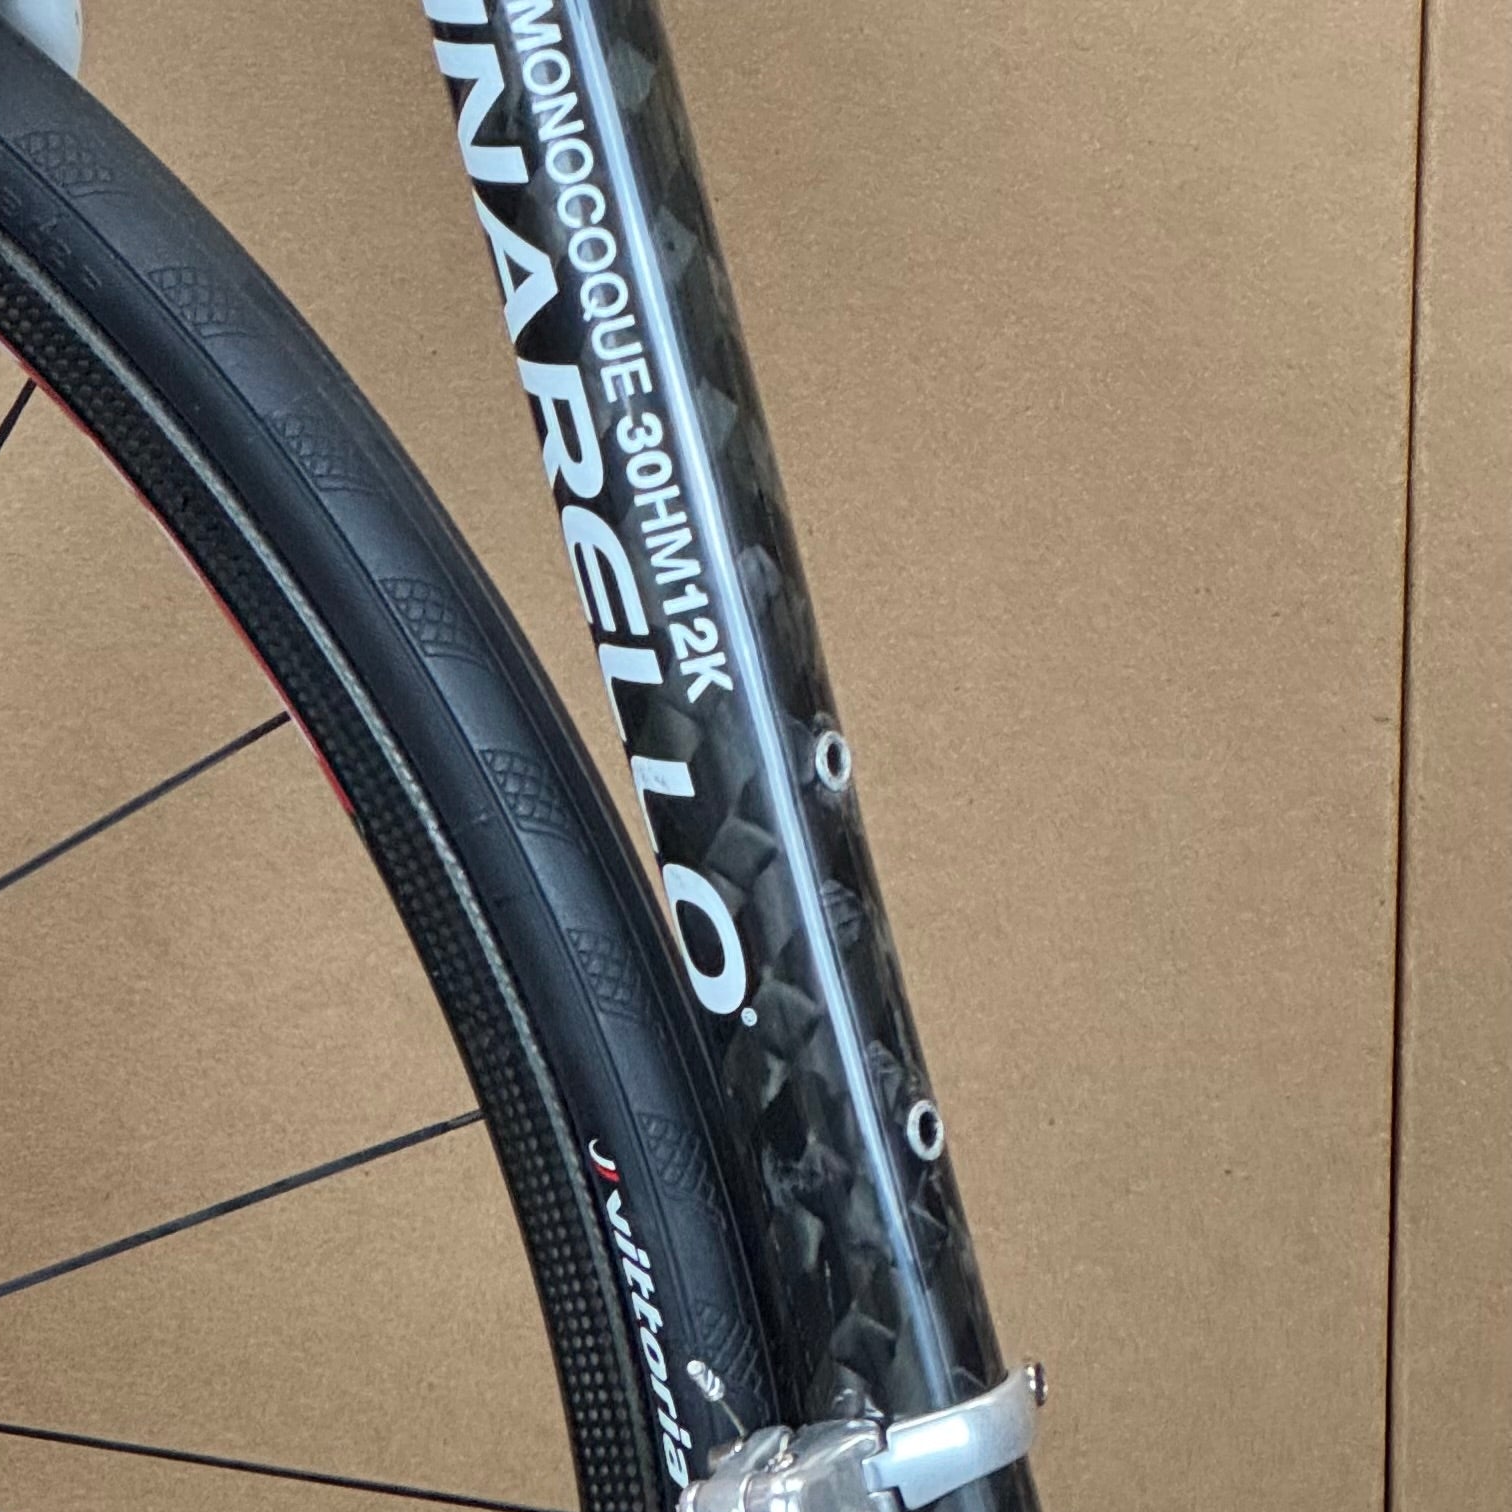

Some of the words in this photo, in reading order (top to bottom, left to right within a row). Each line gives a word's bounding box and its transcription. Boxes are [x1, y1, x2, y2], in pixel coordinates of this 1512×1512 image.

[506, 0, 653, 404] MONOCOQUE
[615, 411, 734, 704] 30HM12K
[606, 1188, 693, 1490] vittoria
